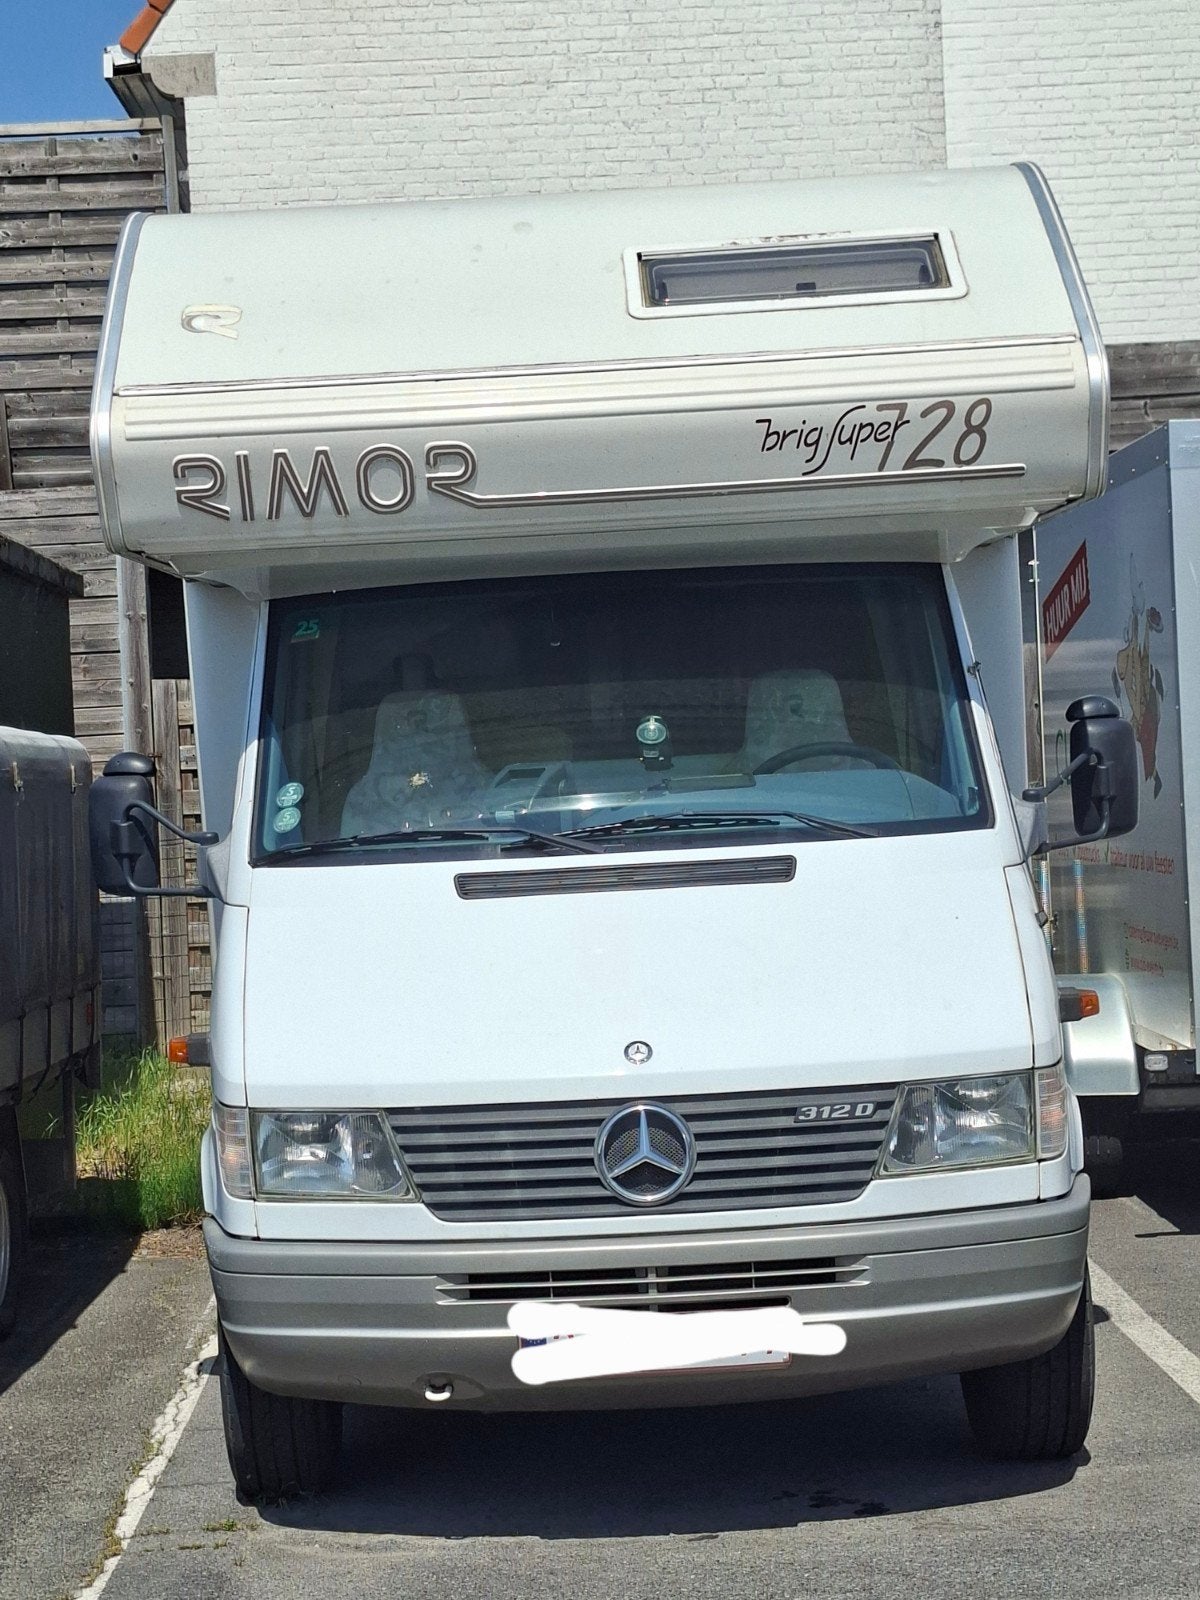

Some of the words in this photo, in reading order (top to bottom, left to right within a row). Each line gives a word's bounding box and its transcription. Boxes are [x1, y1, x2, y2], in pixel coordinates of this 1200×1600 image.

[876, 397, 992, 472] 728
[172, 440, 478, 522] RIMOR
[1045, 583, 1071, 646] HUUR
[798, 1104, 851, 1120] 312
[854, 1103, 874, 1116] D
